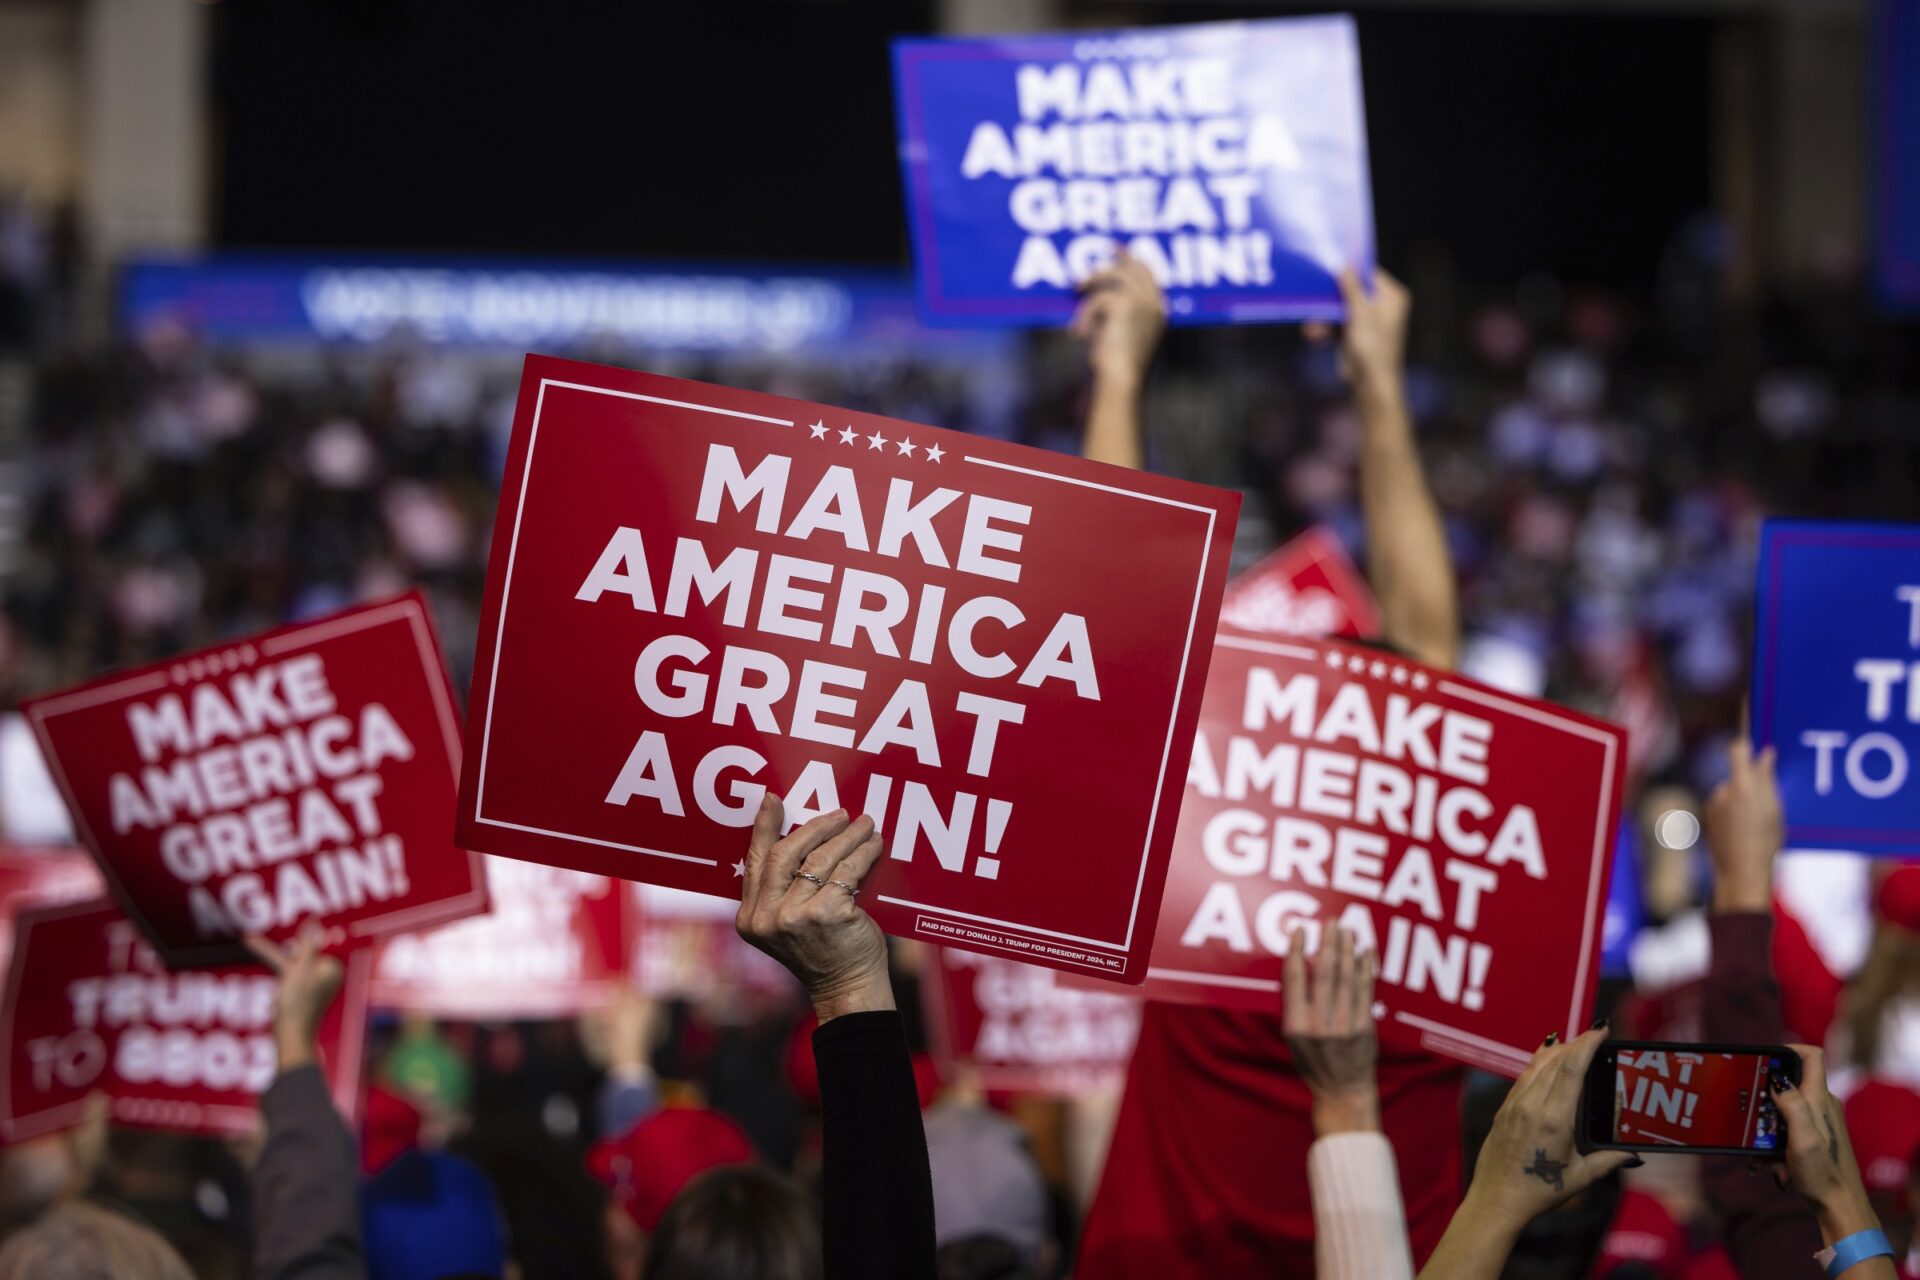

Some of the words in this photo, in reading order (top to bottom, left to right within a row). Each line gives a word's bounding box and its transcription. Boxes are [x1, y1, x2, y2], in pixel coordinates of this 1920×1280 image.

[1016, 58, 1232, 122] MAKE
[961, 114, 1300, 180] AMERICA
[1009, 174, 1258, 234] GREAT
[1012, 230, 1274, 290] AGAIN!
[696, 443, 1032, 583] MAKE
[574, 527, 1101, 701] AMERICA
[125, 652, 338, 762] MAKE
[633, 635, 1026, 778] GREAT
[1242, 667, 1494, 786] MAKE
[109, 702, 415, 834] AMERICA
[604, 730, 1014, 880] AGAIN!
[1185, 730, 1547, 879] AMERICA
[1800, 730, 1909, 799] TO
[160, 772, 383, 882] GREAT
[1202, 809, 1499, 932] GREAT
[186, 834, 411, 935] AGAIN!
[921, 920, 939, 931] PAID
[940, 924, 955, 934] FOR
[956, 928, 966, 936] BY
[966, 930, 997, 942] DONALD
[1005, 938, 1031, 950] TRUMP
[1031, 944, 1047, 953] FOR
[1046, 946, 1086, 961] PRESIDENT
[1086, 955, 1106, 966] 2024,
[1106, 960, 1121, 968] INC.
[1182, 882, 1493, 1012] AGAIN!
[26, 1032, 106, 1090] TO
